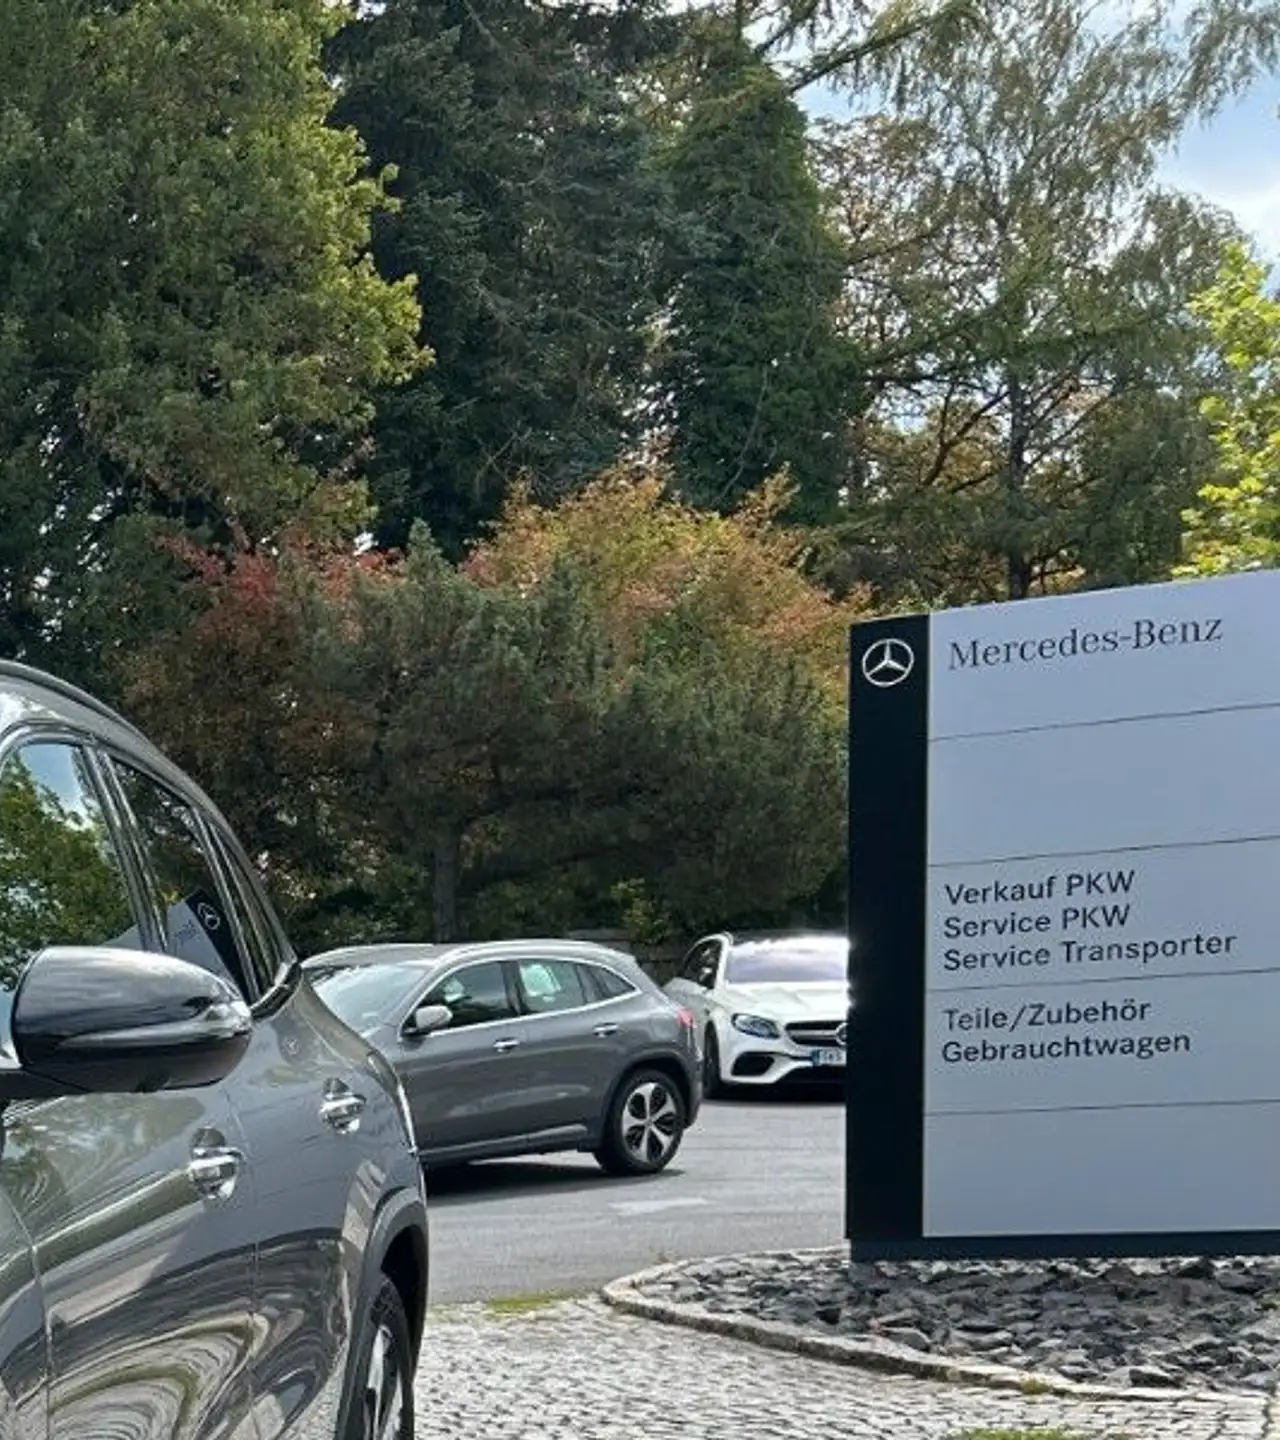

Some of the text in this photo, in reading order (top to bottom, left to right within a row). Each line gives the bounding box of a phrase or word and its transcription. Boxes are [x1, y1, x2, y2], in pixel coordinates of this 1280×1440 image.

[948, 618, 1224, 671] Mercedes-Benz
[944, 870, 1136, 906] Verkauf PKW
[943, 903, 1132, 939] Service PKW
[943, 933, 1238, 971] Service Transporter
[943, 998, 1152, 1032] Teile/Zubehör
[941, 1032, 1192, 1063] Gebrauchtwagen
